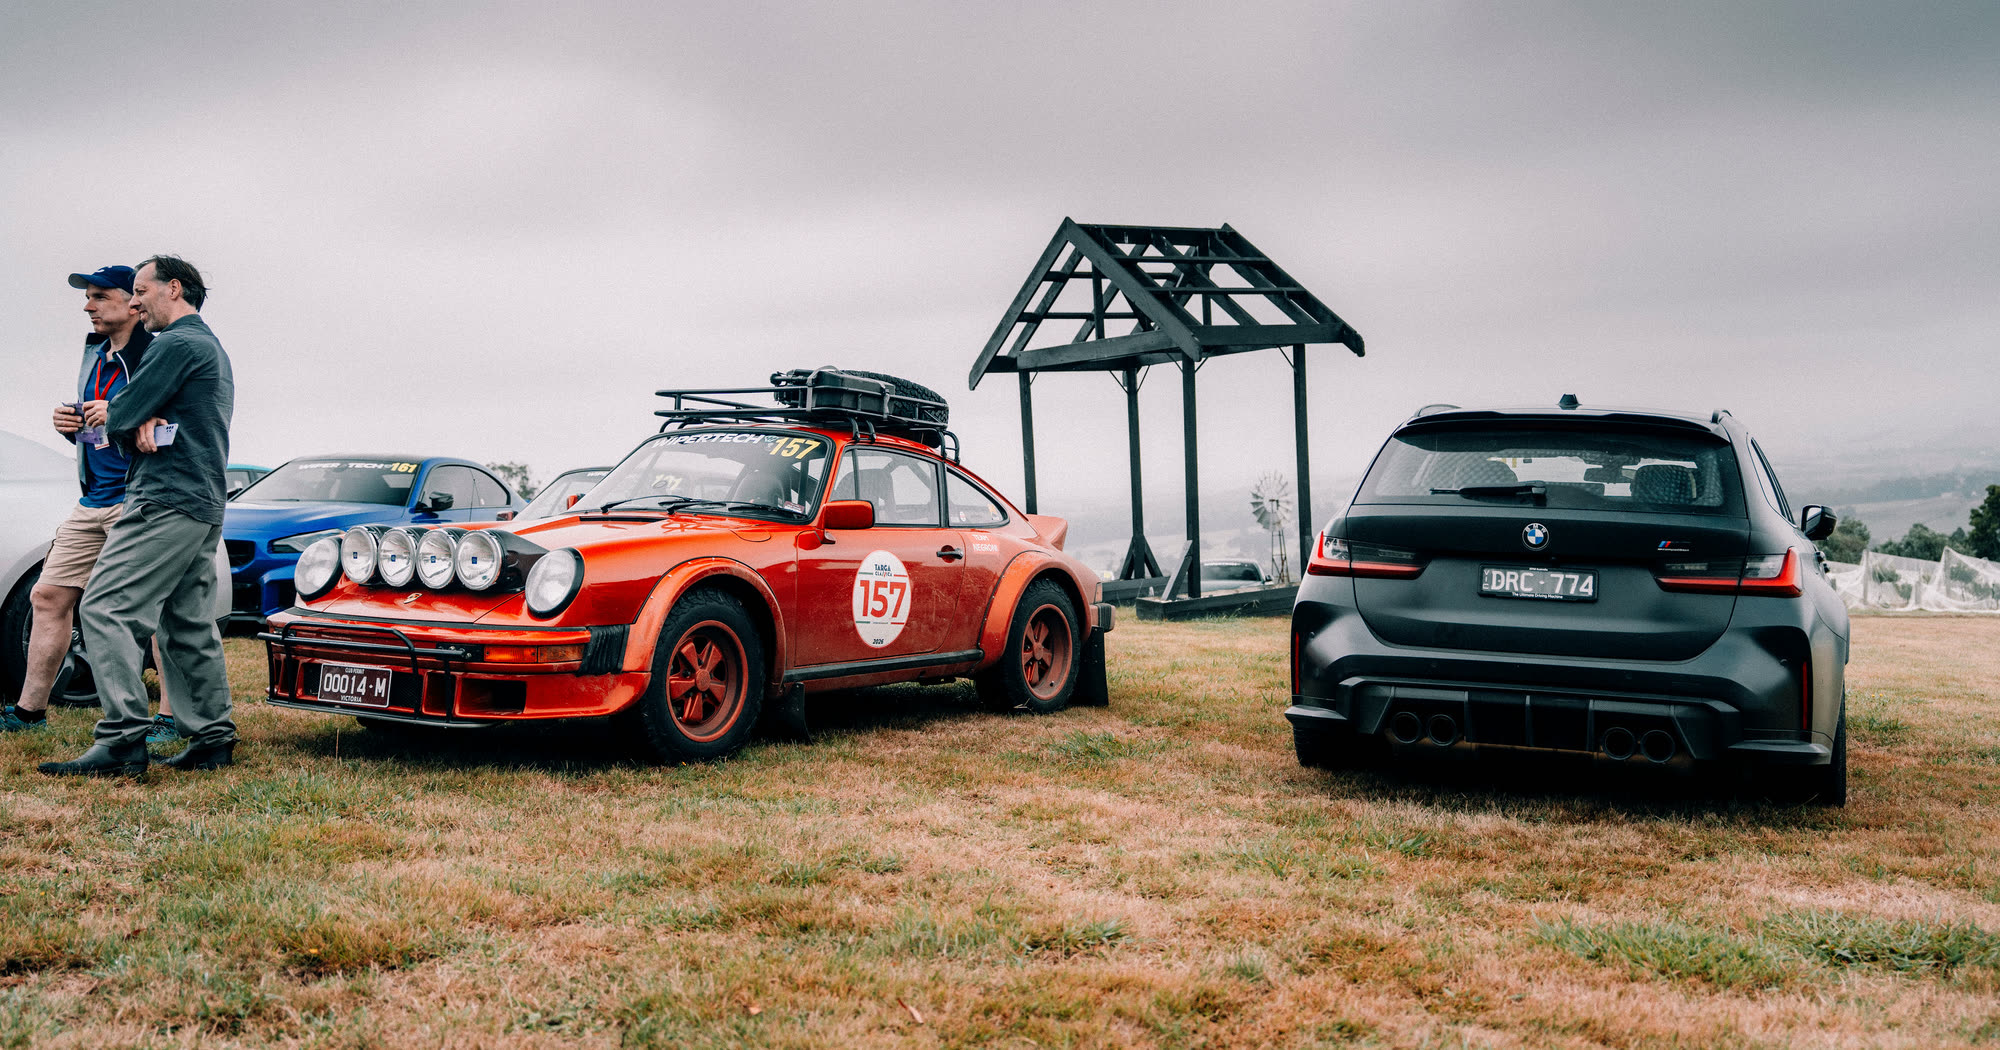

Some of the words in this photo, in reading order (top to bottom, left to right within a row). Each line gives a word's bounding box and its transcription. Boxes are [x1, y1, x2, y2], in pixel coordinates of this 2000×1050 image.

[652, 433, 765, 449] WIPERTECH
[769, 437, 821, 460] 157
[299, 462, 340, 470] WIPER
[391, 462, 418, 473] 161
[972, 543, 998, 552] NEGRONI
[874, 563, 891, 571] TARGA
[859, 579, 907, 618] 157
